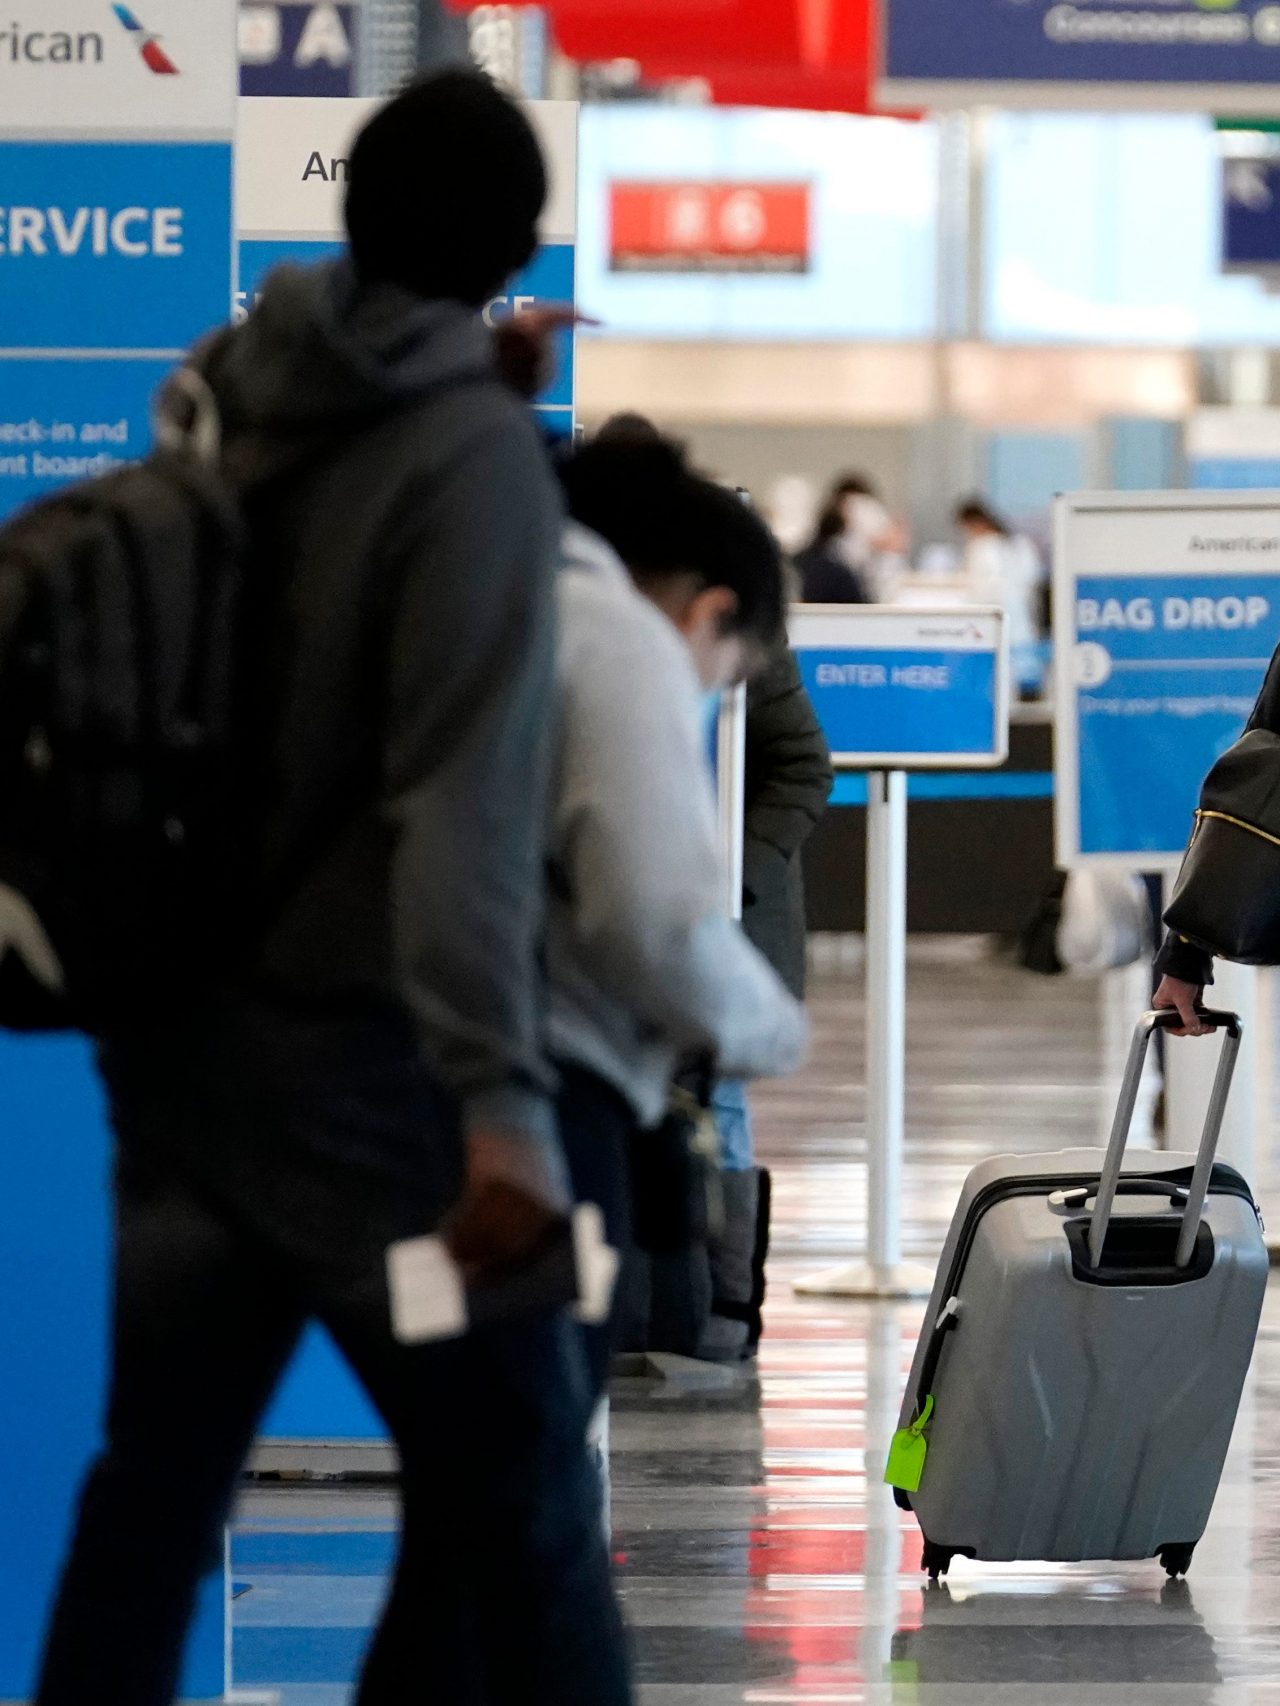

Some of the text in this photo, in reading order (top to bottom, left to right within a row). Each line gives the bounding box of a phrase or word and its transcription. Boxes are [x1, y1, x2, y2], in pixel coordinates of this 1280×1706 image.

[0, 206, 184, 257] RVICE
[80, 418, 128, 443] and
[1077, 596, 1269, 632] BAG DROP
[815, 663, 950, 690] ENTER HERE
